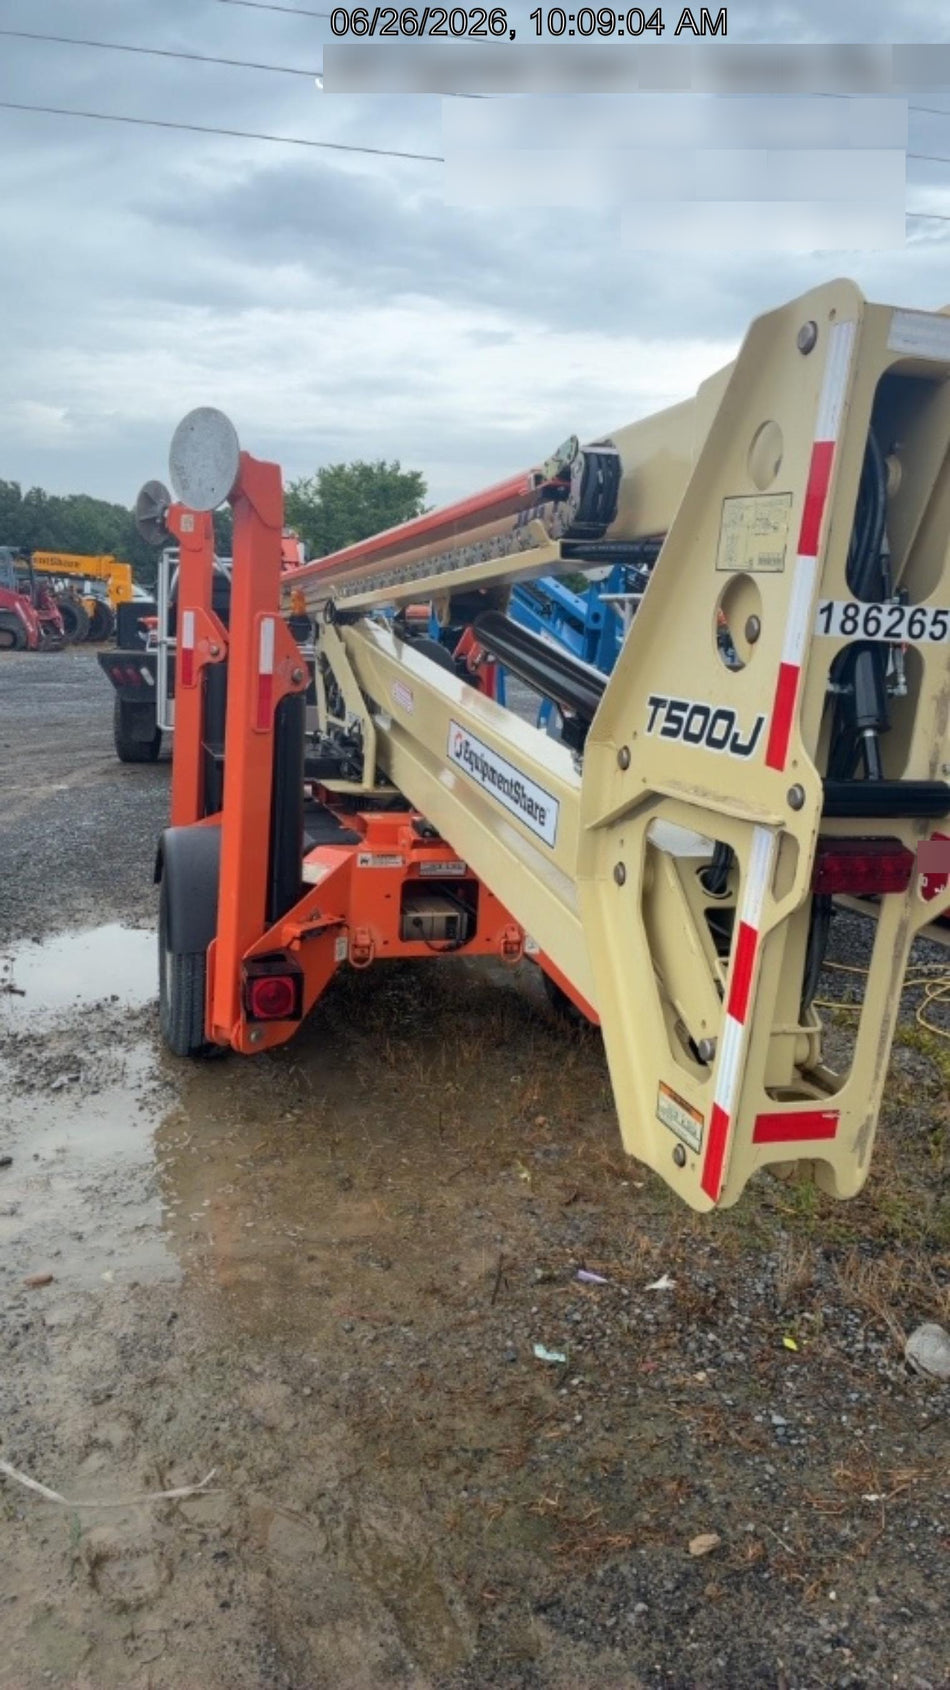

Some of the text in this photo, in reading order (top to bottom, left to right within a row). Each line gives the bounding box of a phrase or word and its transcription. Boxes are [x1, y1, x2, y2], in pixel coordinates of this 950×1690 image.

[819, 602, 949, 641] 186265
[647, 696, 765, 757] T500J
[463, 740, 547, 827] EquipmentShare
